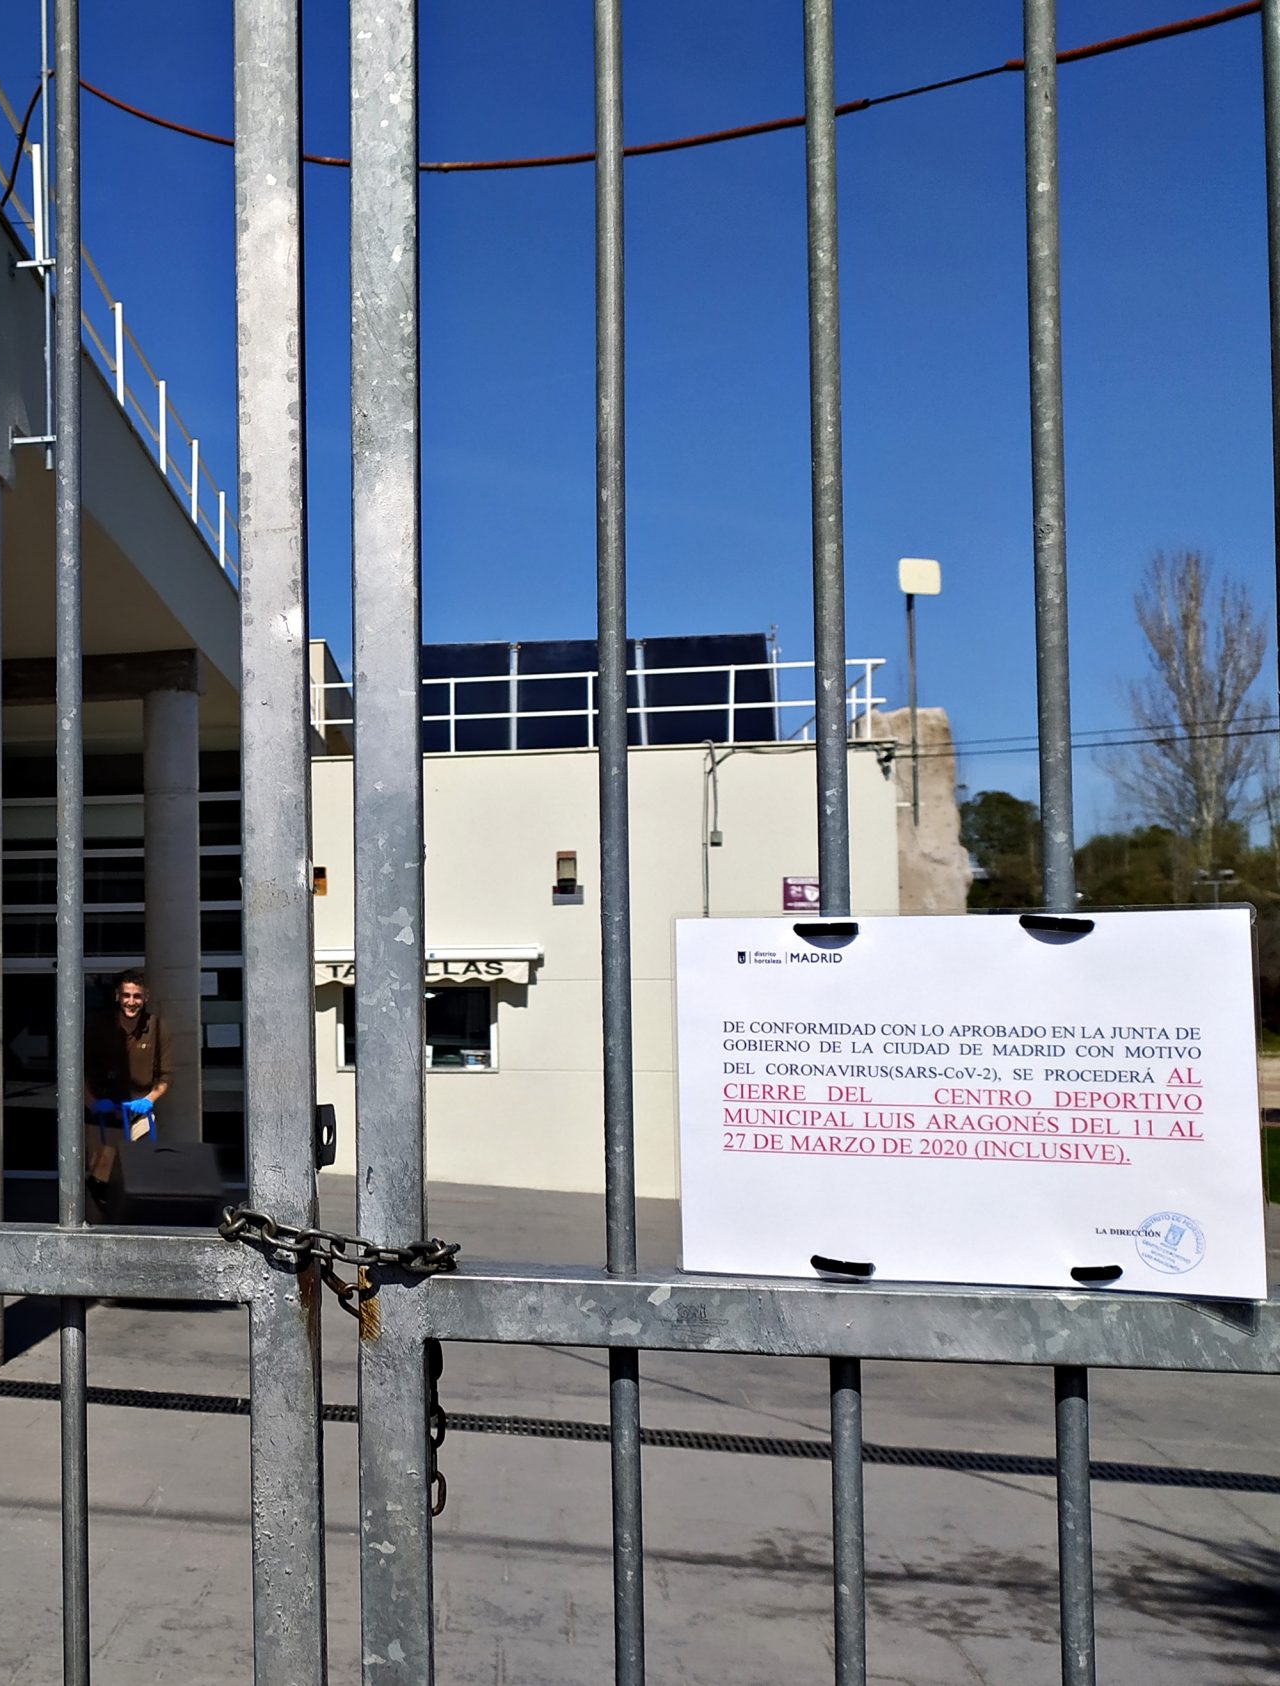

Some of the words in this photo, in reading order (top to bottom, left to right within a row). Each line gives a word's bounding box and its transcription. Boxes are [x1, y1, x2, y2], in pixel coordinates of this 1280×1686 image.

[790, 952, 843, 964] MADRID
[326, 961, 505, 979] TALLAS
[723, 1021, 745, 1034] DE
[750, 1021, 876, 1037] CONFORMIDAD
[881, 1024, 917, 1037] CON
[922, 1024, 945, 1037] LO
[949, 1025, 1047, 1039] APROBADO
[1052, 1026, 1076, 1039] EN
[1081, 1026, 1106, 1039] LA
[1111, 1027, 1170, 1040] JUNTA
[1176, 1027, 1202, 1041] DE
[723, 1039, 811, 1053] GOBIERNO
[820, 1040, 843, 1054] DE
[851, 1041, 874, 1054] LA
[883, 1042, 950, 1056] CIUDAD
[960, 1043, 983, 1056] DE
[992, 1044, 1066, 1058] MADRID
[1075, 1045, 1115, 1059] CON
[1125, 1046, 1202, 1060] MOTIVO
[723, 1062, 756, 1075] DEL
[1013, 1068, 1034, 1081] SE
[1044, 1067, 1155, 1084] PROCEDERÁ
[1167, 1067, 1203, 1085] AL
[723, 1083, 807, 1101] CIERRE
[828, 1085, 873, 1102] DEL
[934, 1088, 1032, 1107] CENTRO
[1055, 1091, 1203, 1112] DEPORTIVO
[723, 1108, 854, 1128] MUNICIPAL
[864, 1111, 916, 1129] LUIS
[926, 1112, 1060, 1134] ARAGONÉS
[1071, 1117, 1121, 1136] DEL
[1134, 1119, 1155, 1137] 11
[1168, 1121, 1204, 1139] AL
[723, 1132, 747, 1150] 27
[753, 1133, 784, 1151] DE
[791, 1135, 875, 1153] MARZO
[882, 1137, 914, 1155] DE
[920, 1139, 968, 1157] 2020
[974, 1140, 1131, 1164] (INCLUSIVE).
[1095, 1227, 1108, 1235] LA
[1109, 1228, 1162, 1238] DIRECCIÓN
